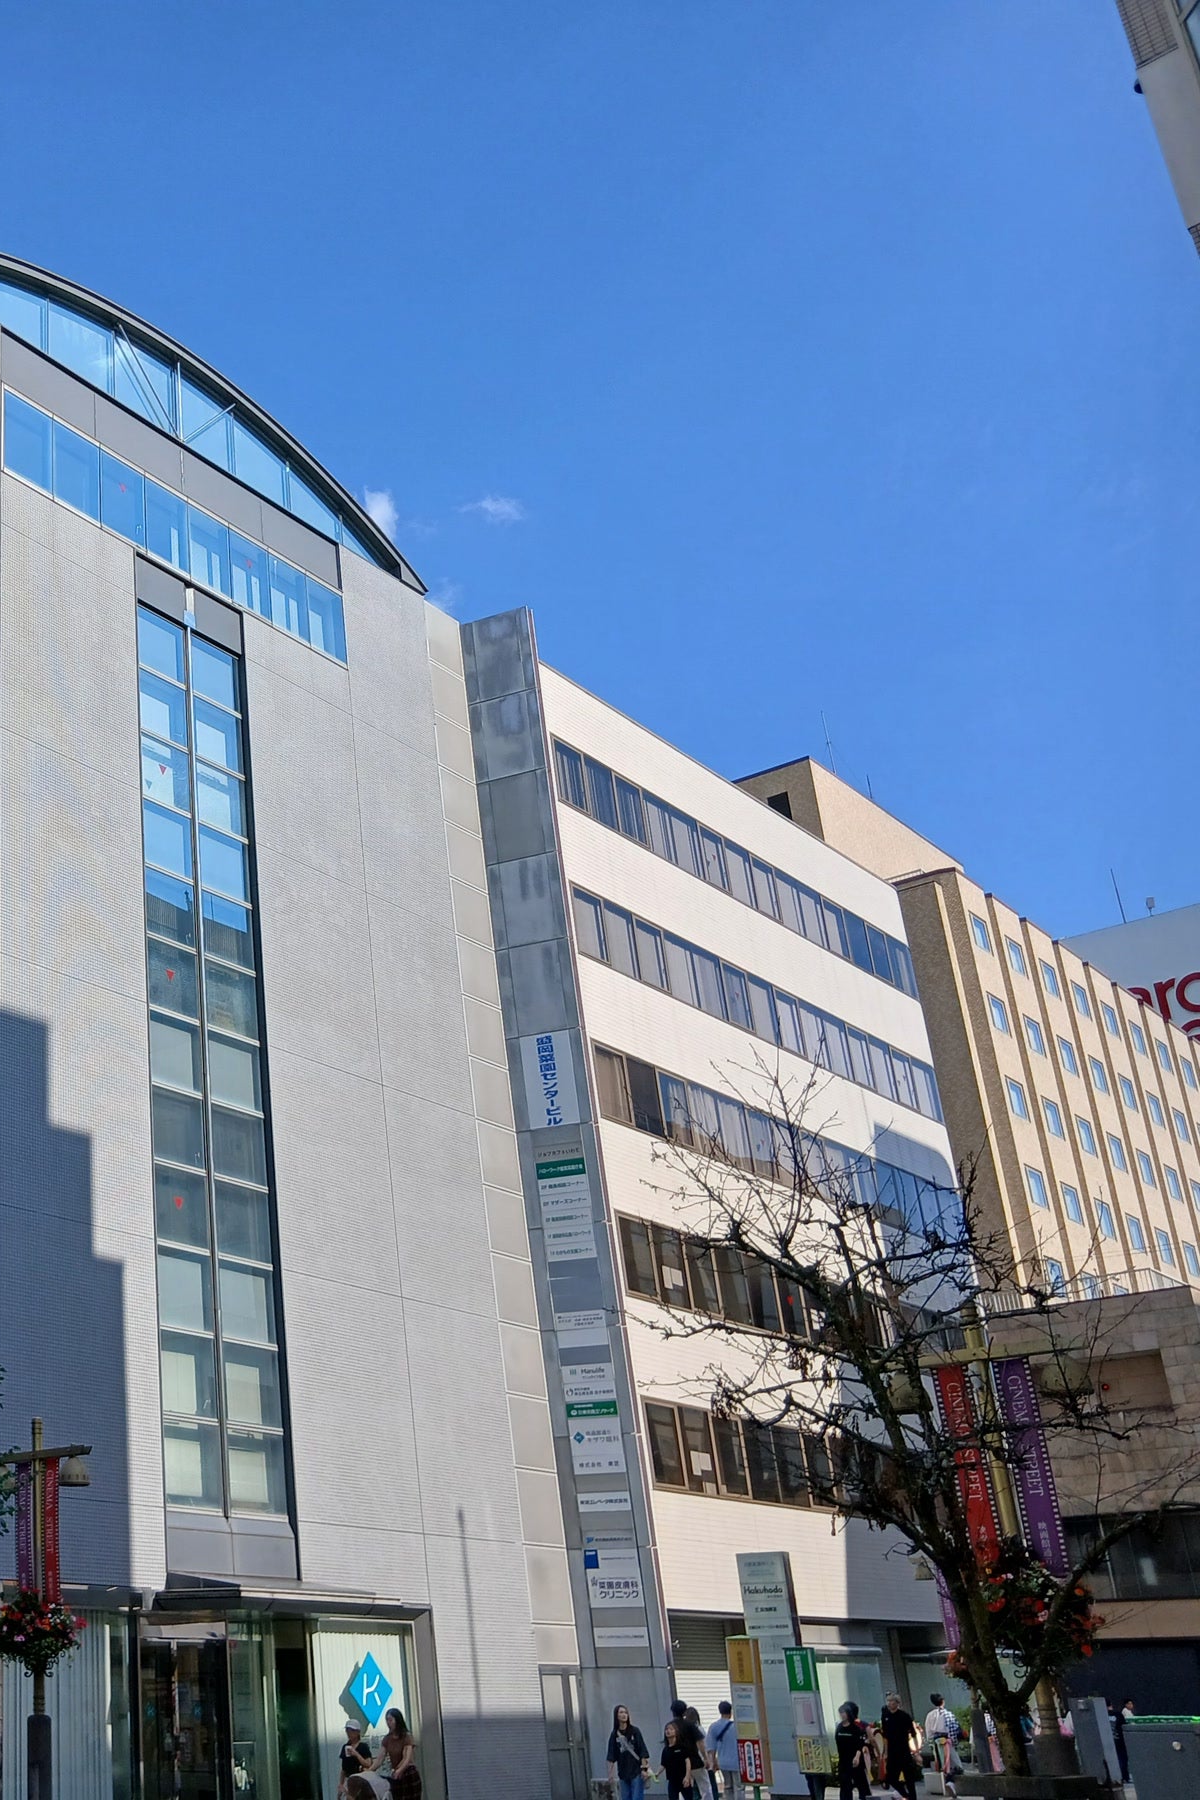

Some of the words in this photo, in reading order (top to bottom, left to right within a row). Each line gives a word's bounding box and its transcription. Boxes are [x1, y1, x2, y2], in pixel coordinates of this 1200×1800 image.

[535, 1035, 563, 1126] 盛岡菜園センタービル
[1006, 1375, 1029, 1428] CINEM
[46, 1517, 54, 1554] STREET
[599, 1590, 640, 1600] クリニック
[743, 1585, 784, 1595] Hakuhodo
